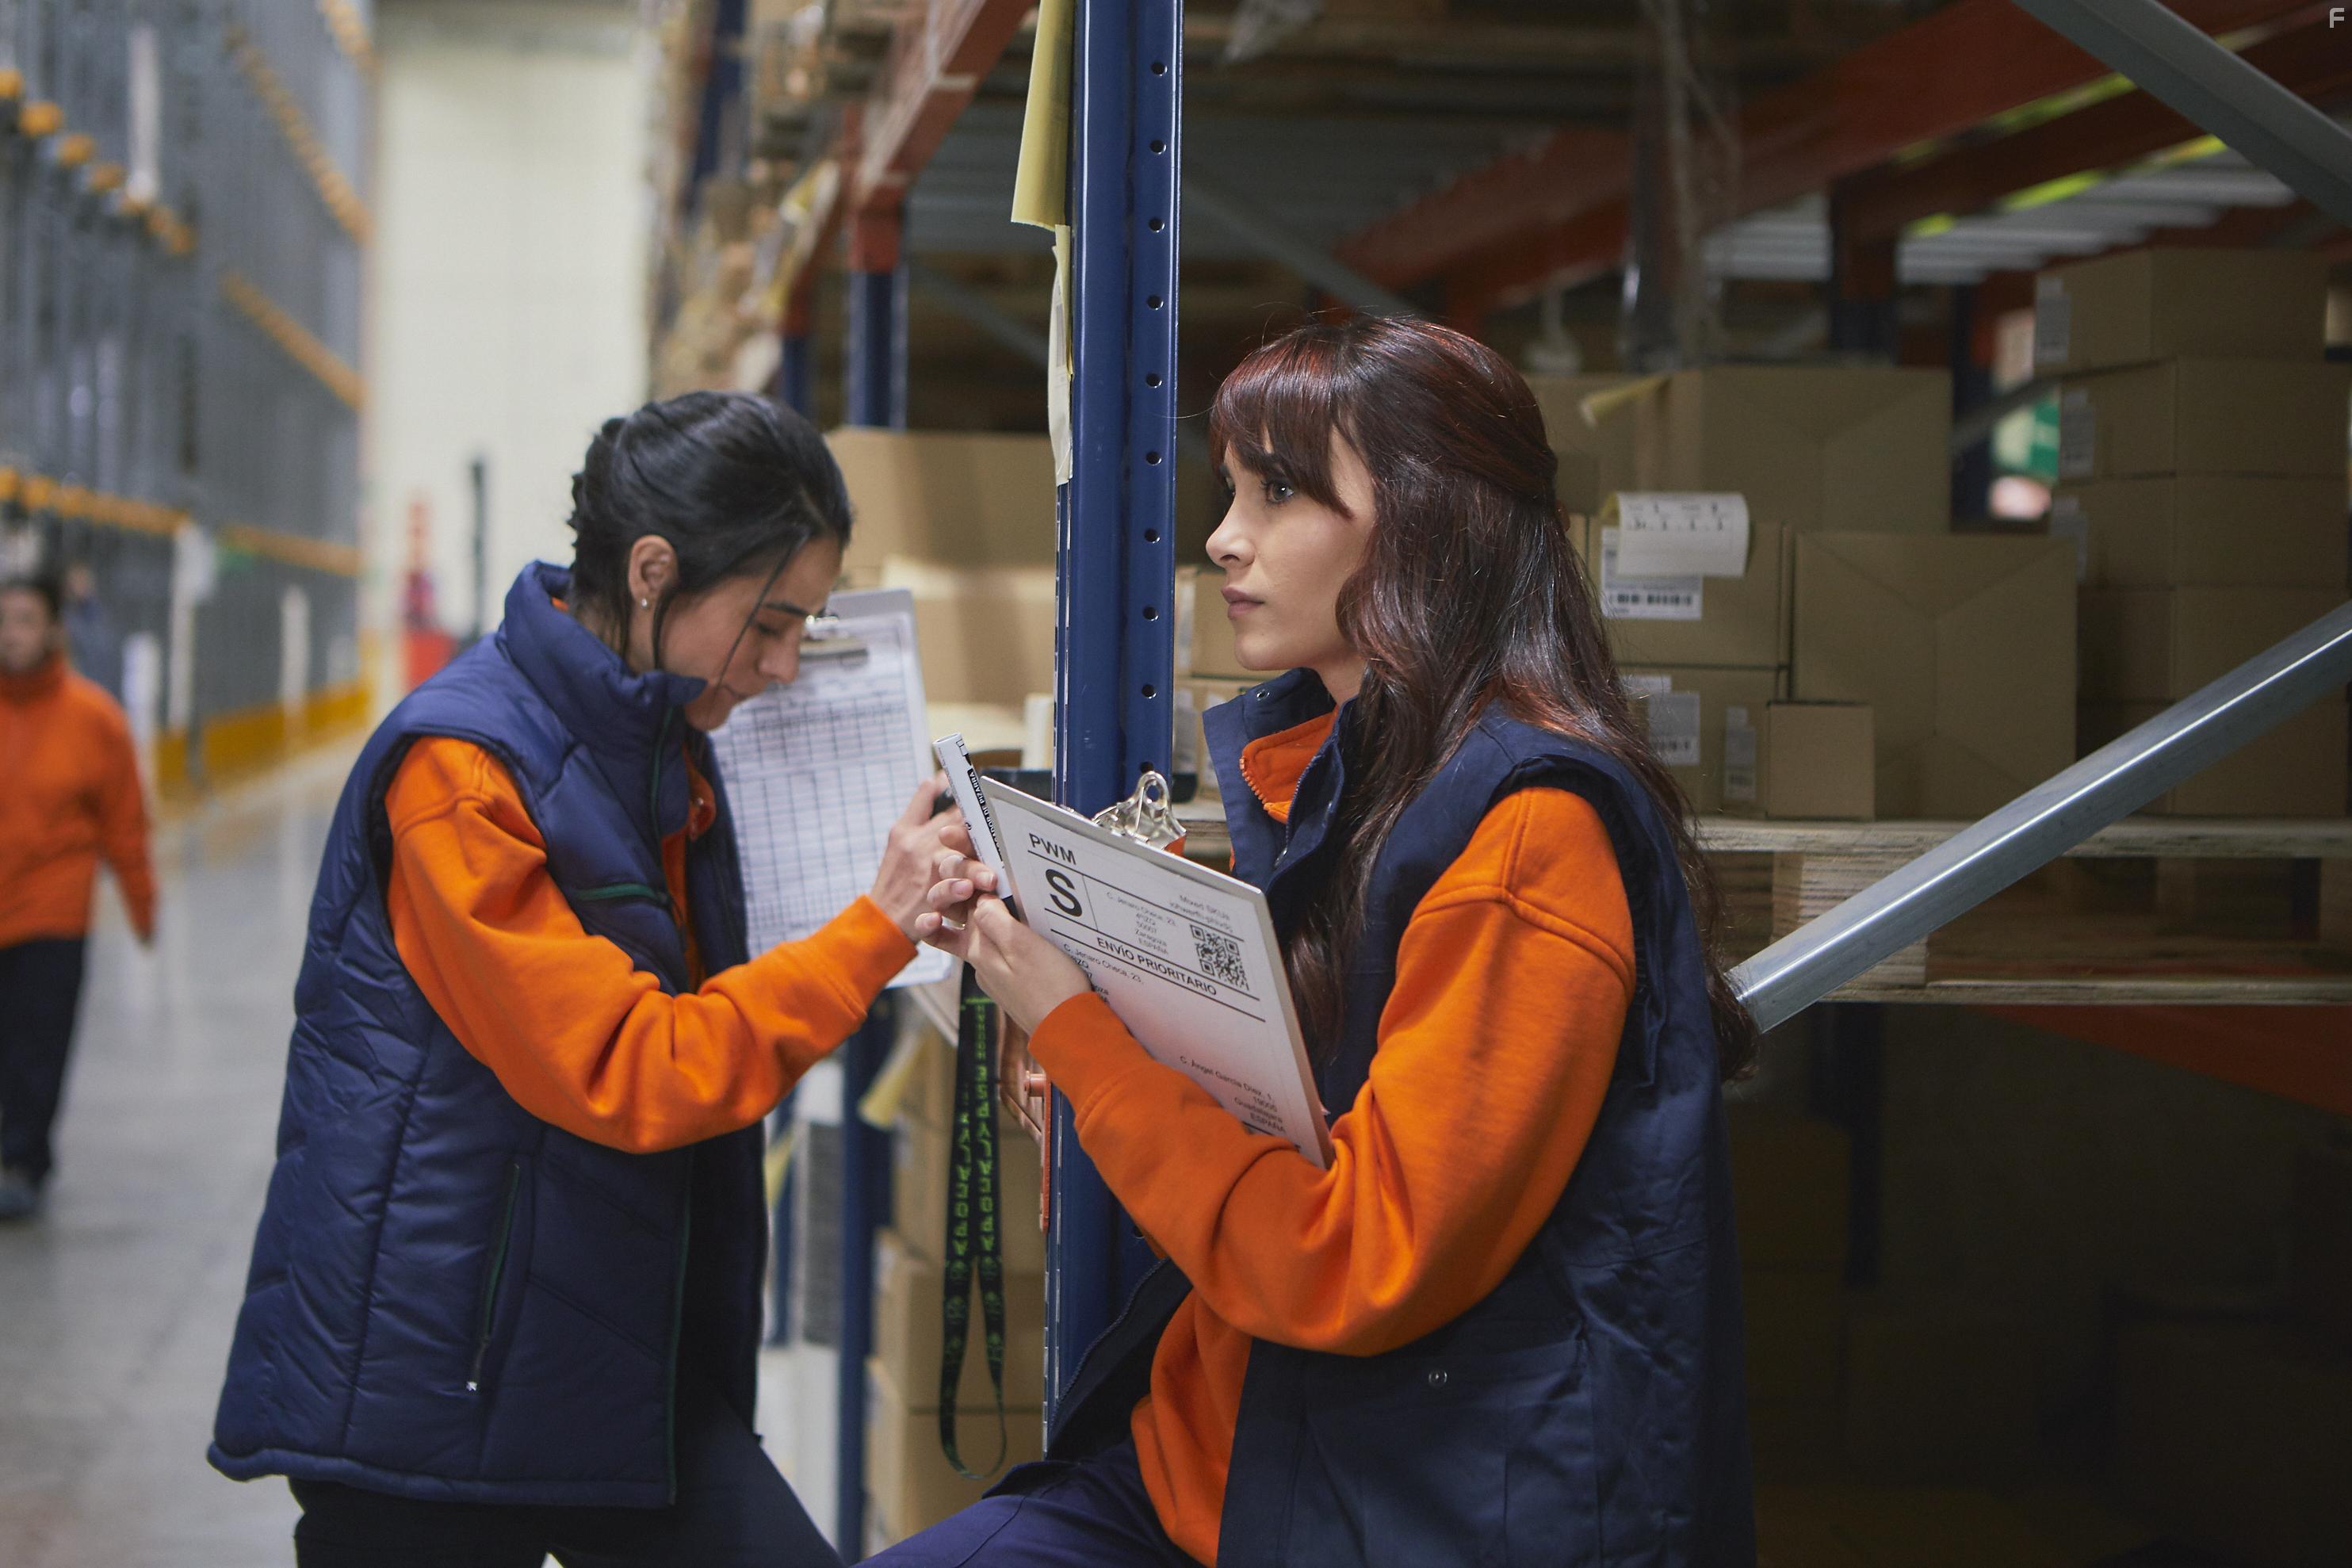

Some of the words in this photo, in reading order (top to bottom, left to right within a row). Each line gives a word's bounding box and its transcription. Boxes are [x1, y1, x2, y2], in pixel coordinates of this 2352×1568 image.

[969, 771, 986, 805] PIZARRA
[1028, 832, 1077, 866] PWM
[1045, 869, 1083, 917] S
[1096, 937, 1134, 961] ENVÍO
[1137, 954, 1217, 996] PRIORITARIO
[975, 1065, 995, 1252] APOCALYPSE
